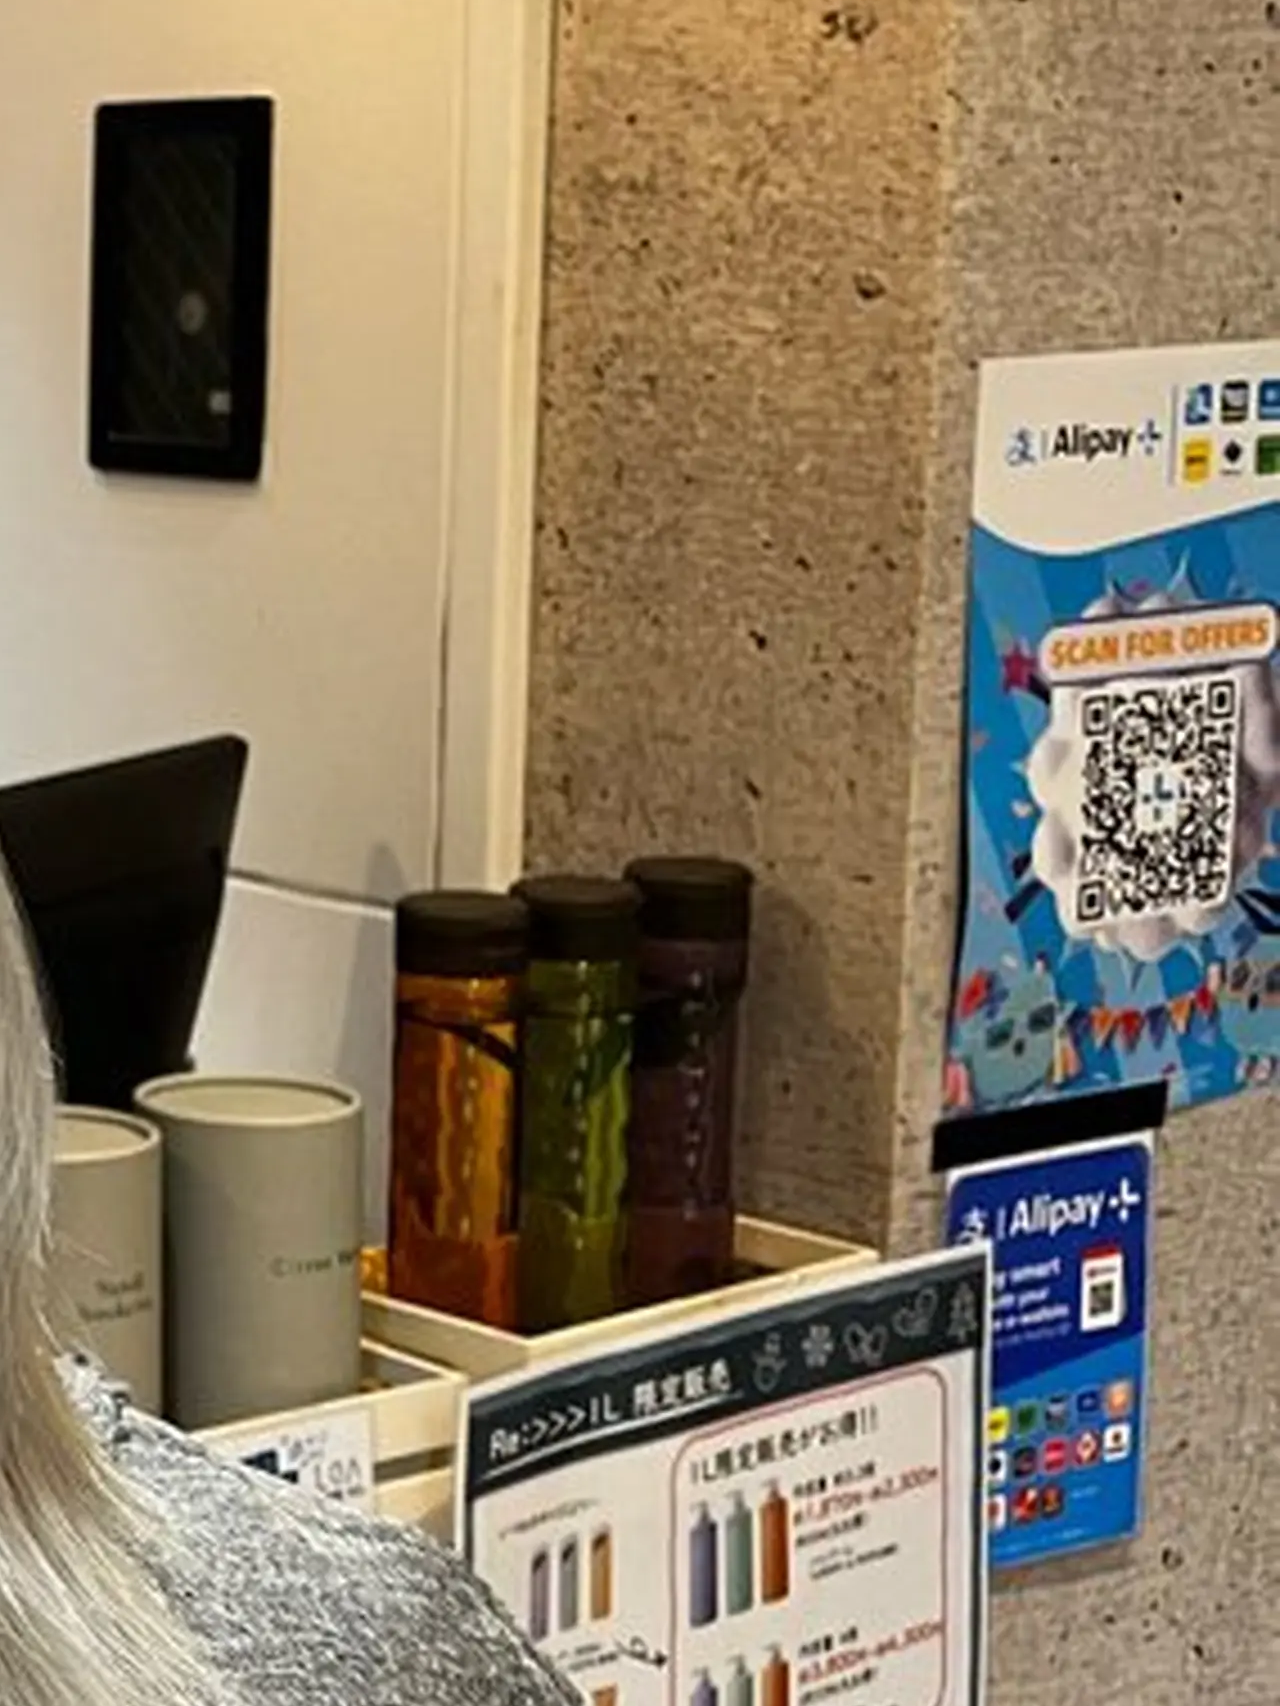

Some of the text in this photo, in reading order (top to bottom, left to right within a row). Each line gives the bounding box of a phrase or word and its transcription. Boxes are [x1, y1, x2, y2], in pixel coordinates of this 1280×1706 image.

[1050, 618, 1270, 670] SCAN FOR OFFERS
